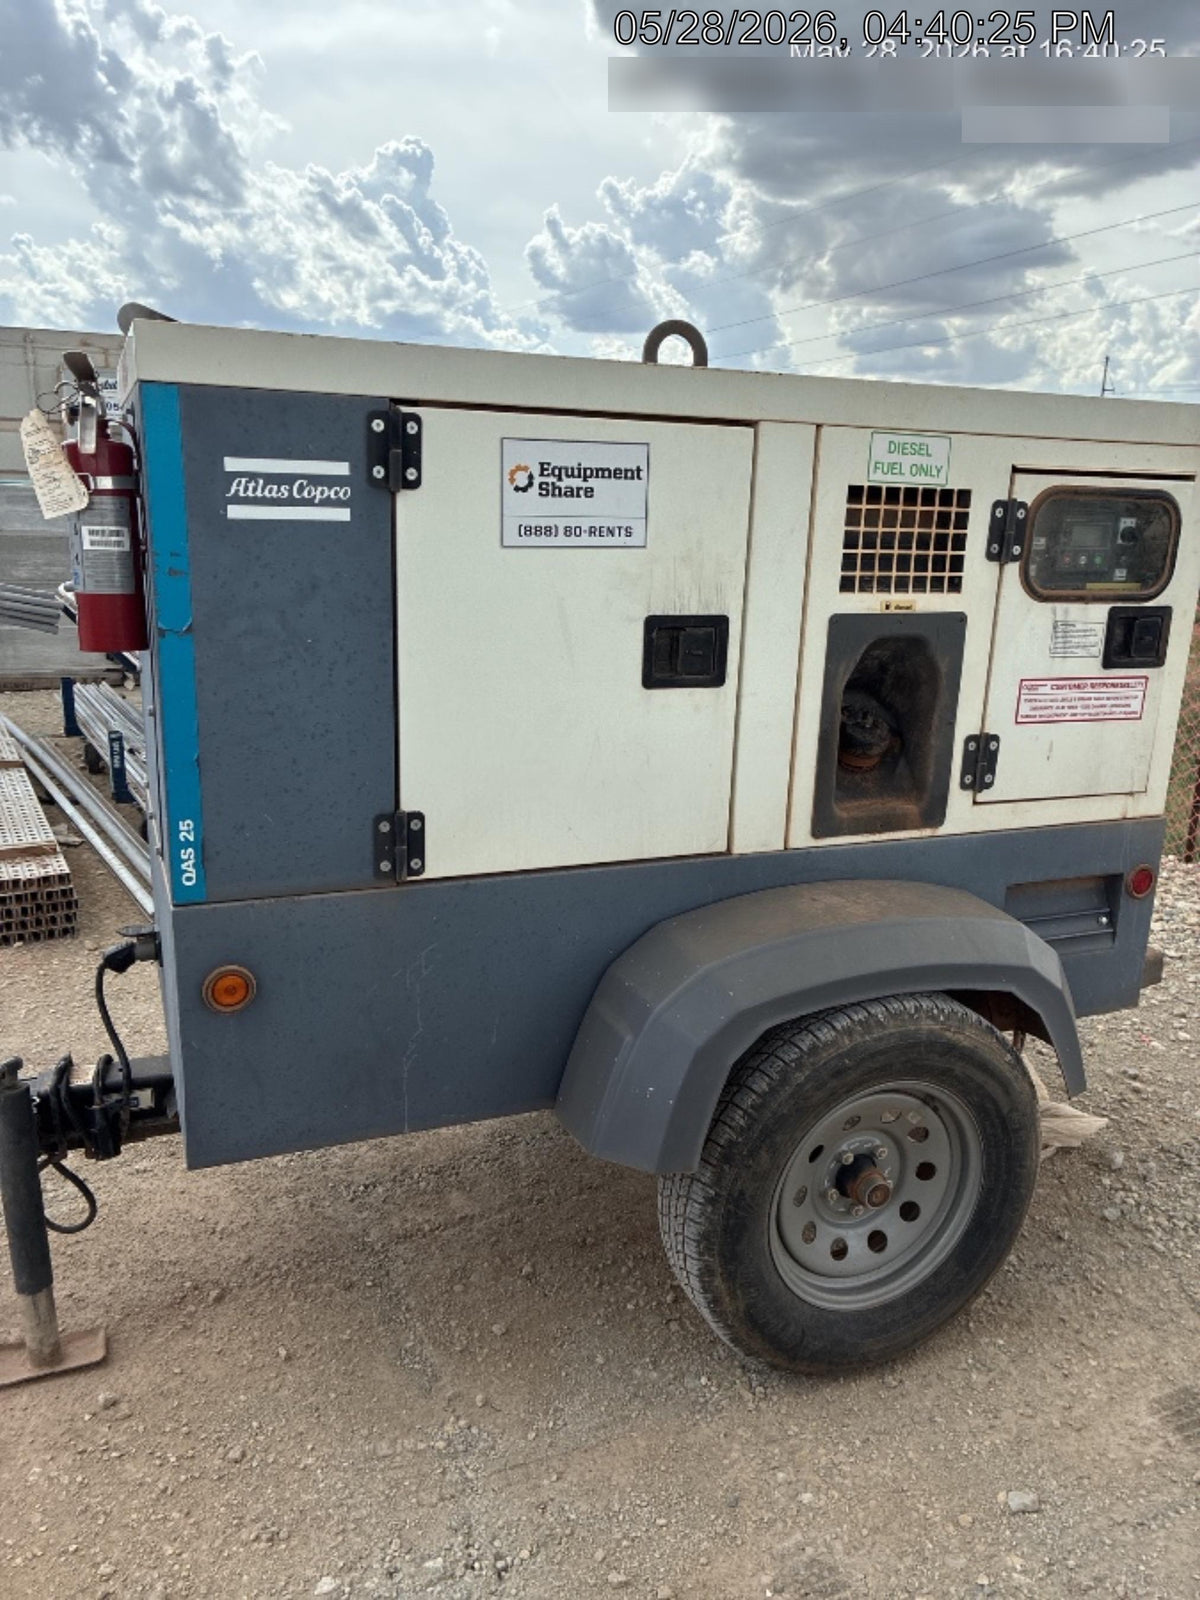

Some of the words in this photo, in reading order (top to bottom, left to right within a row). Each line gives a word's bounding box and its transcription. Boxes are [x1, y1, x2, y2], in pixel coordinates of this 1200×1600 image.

[888, 440, 932, 457] DIESEL
[538, 461, 643, 482] Equipment
[873, 461, 905, 475] FUEL
[910, 463, 943, 478] ONLY
[225, 477, 290, 499] Atlas
[292, 478, 351, 504] Copco
[538, 481, 594, 499] Share
[518, 524, 559, 538] (888)
[563, 525, 634, 538] 80-RENTS
[179, 818, 195, 842] 25
[180, 847, 197, 886] QAS
